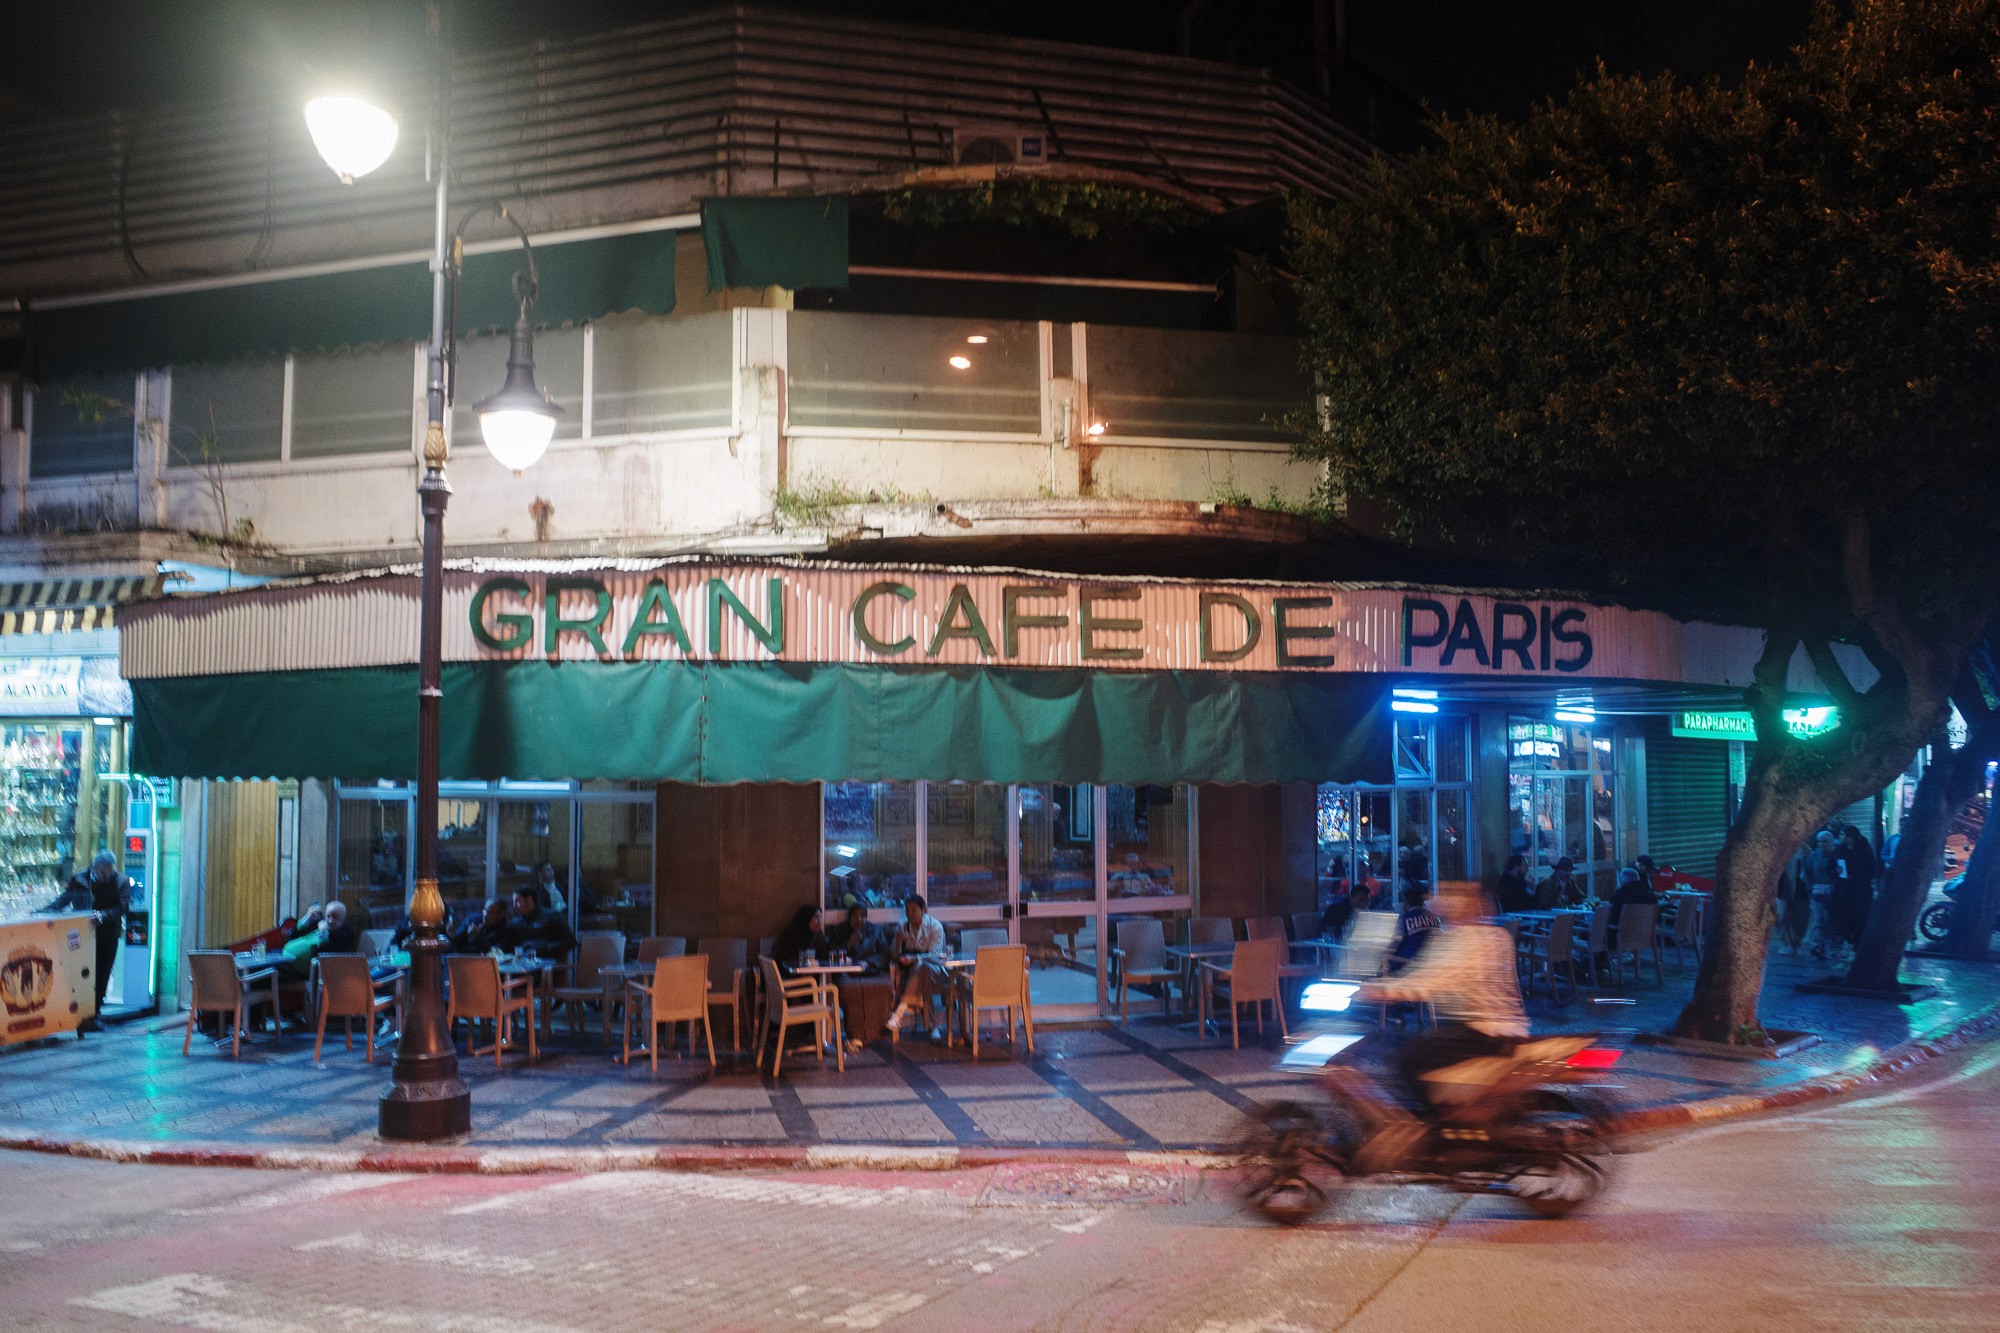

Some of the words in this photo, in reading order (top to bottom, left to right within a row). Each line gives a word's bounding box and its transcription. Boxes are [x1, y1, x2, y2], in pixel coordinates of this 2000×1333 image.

[468, 576, 783, 657] GRAN
[853, 582, 1144, 661] CAFE
[1198, 591, 1336, 668] DE
[1401, 597, 1595, 673] PARIS
[1684, 712, 1755, 733] PARAPHARMACIE
